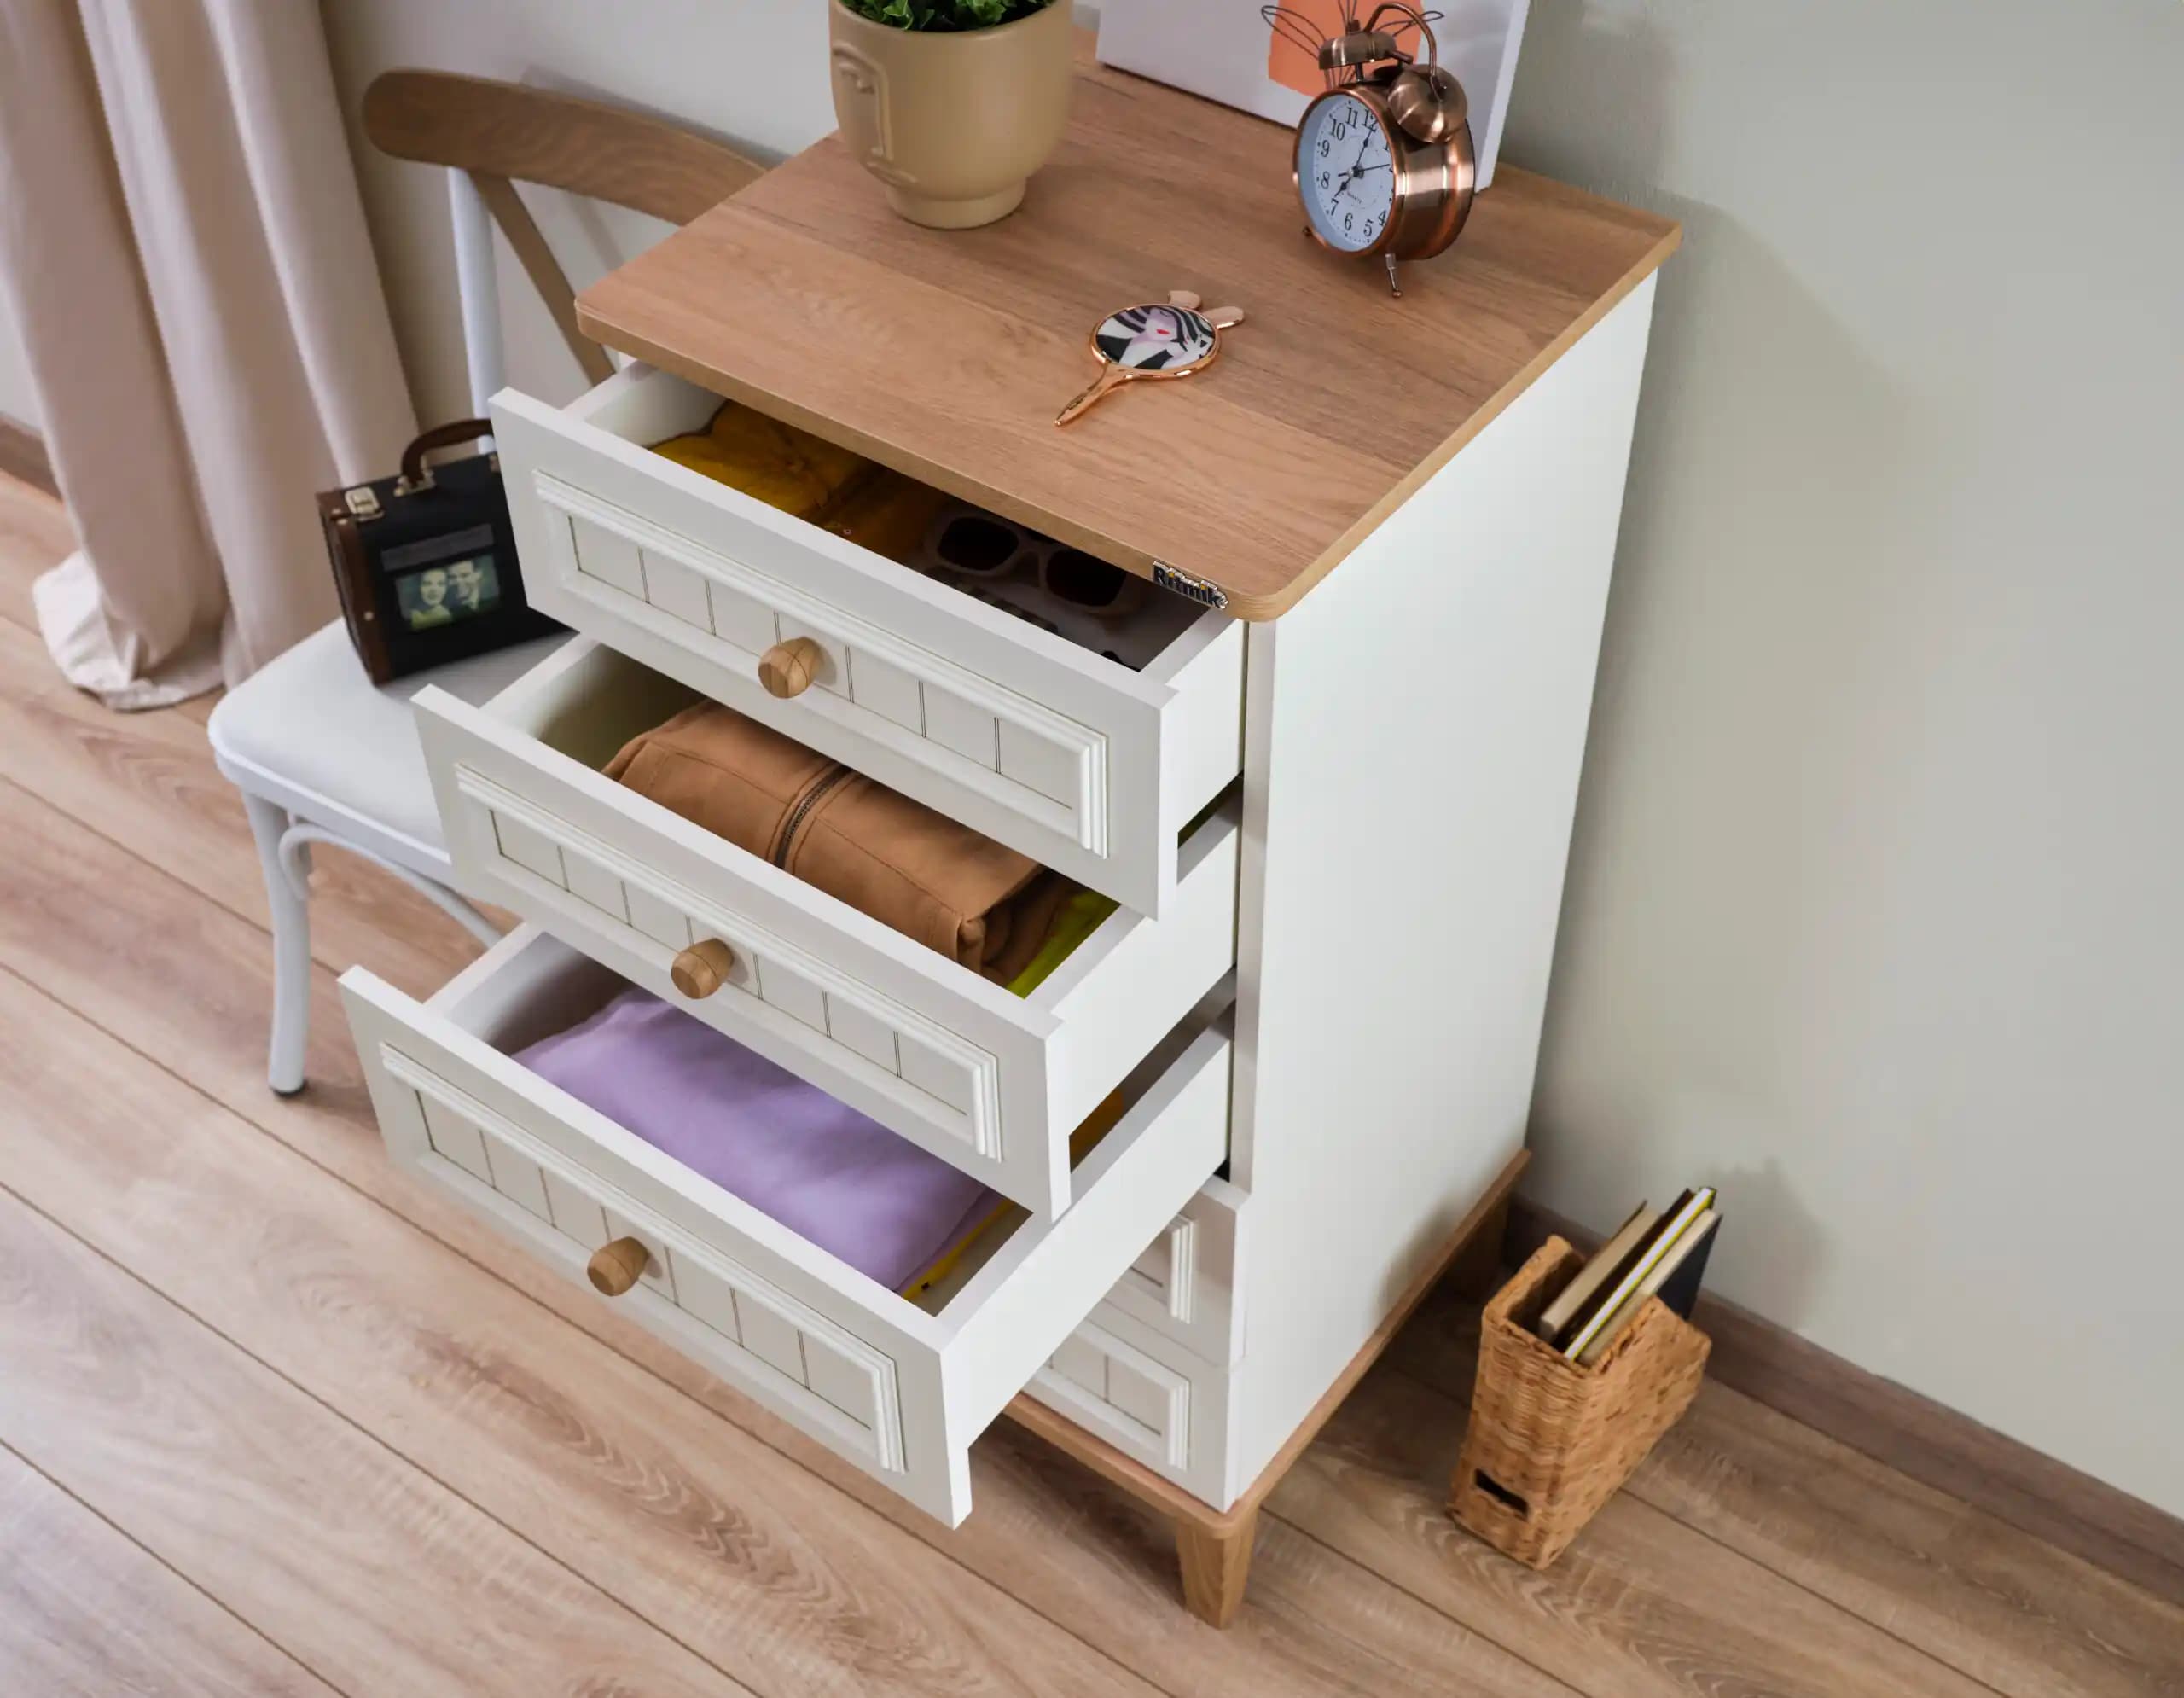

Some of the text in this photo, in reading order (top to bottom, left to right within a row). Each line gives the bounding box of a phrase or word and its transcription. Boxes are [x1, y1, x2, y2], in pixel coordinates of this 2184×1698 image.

[1345, 106, 1358, 129] 11
[1362, 108, 1378, 132] 12
[1329, 118, 1345, 141] 10
[1321, 139, 1330, 158] 9
[1321, 170, 1330, 189] 8
[1330, 197, 1339, 216] 7
[1345, 212, 1354, 231] 6
[1363, 218, 1374, 237] 5
[1378, 209, 1387, 227] 4
[1153, 561, 1228, 609] Ritmik
